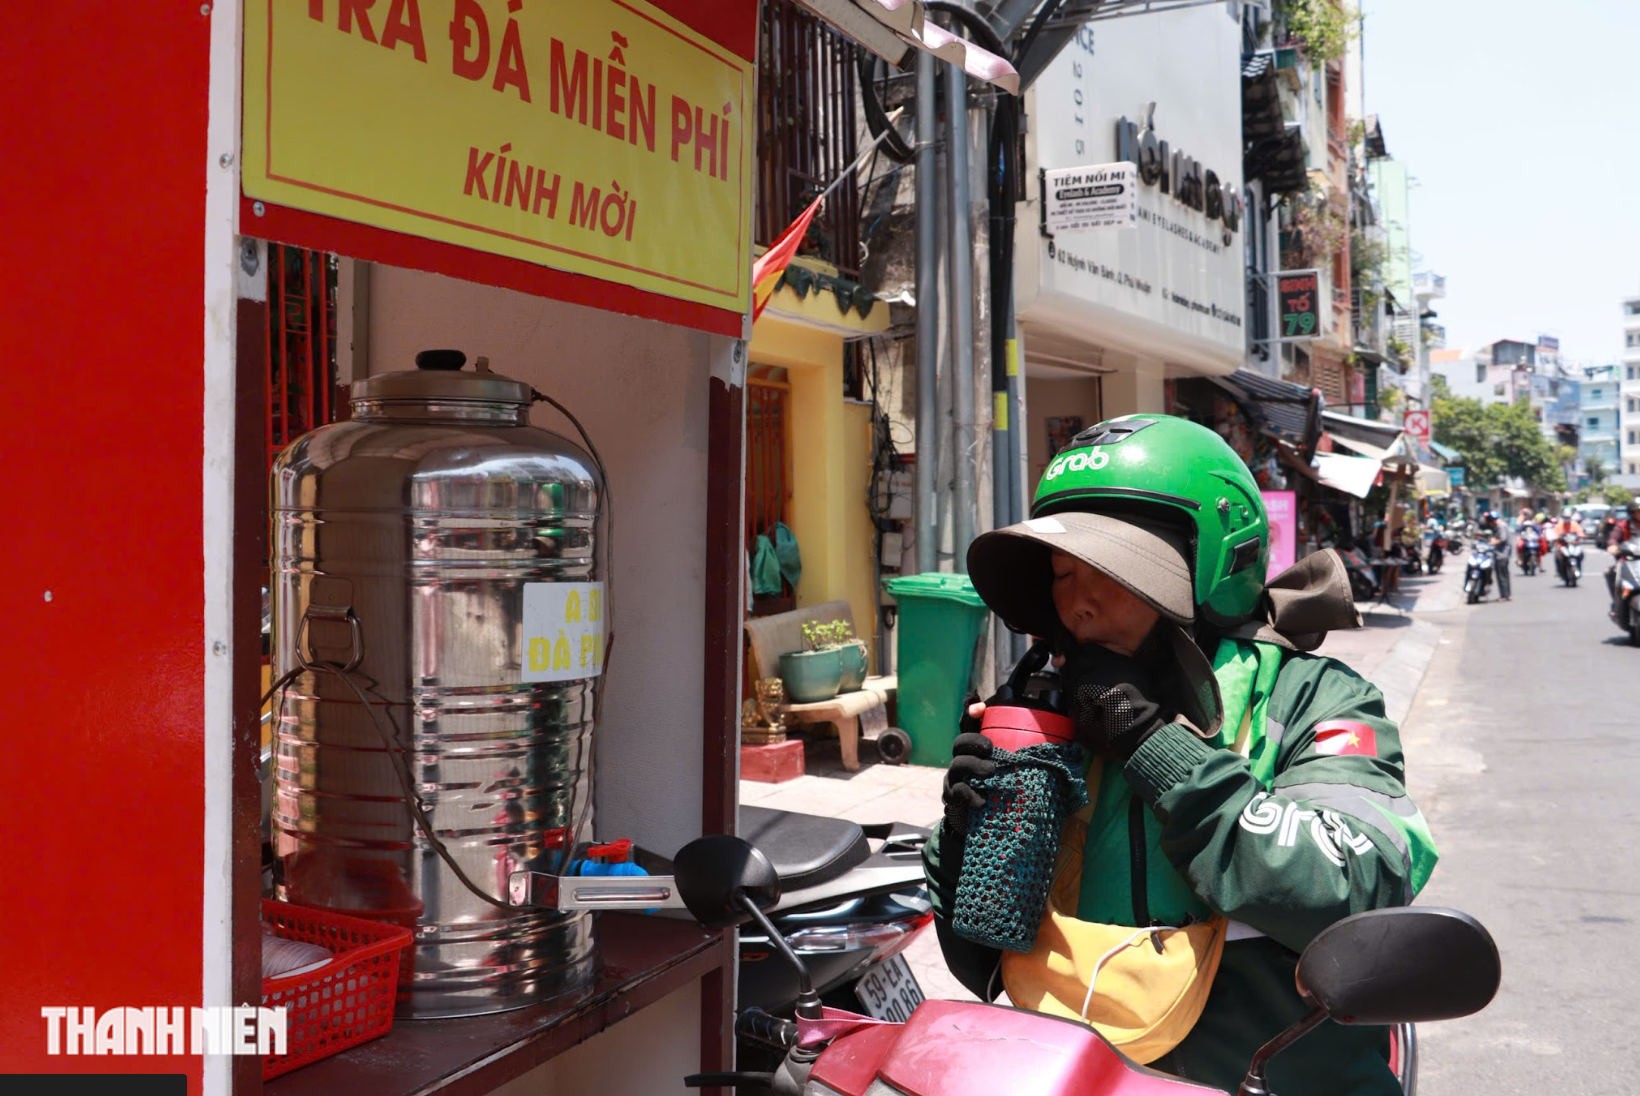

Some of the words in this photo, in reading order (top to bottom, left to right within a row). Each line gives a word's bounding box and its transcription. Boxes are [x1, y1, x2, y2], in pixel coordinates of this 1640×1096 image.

[549, 31, 656, 153] MIỄN
[670, 95, 733, 182] PHÍ
[463, 142, 562, 220] KÍNH
[568, 178, 638, 242] MỜI
[1053, 174, 1083, 188] TIỆM
[1085, 168, 1107, 184] NỐI
[1110, 171, 1126, 181] MI
[1281, 277, 1317, 292] SINH
[1287, 291, 1311, 313] TỐ
[1283, 312, 1316, 336] 79
[1046, 445, 1110, 481] Grab
[564, 589, 581, 624] A
[526, 629, 571, 672] ĐÀ
[864, 958, 904, 1010] 59-EA
